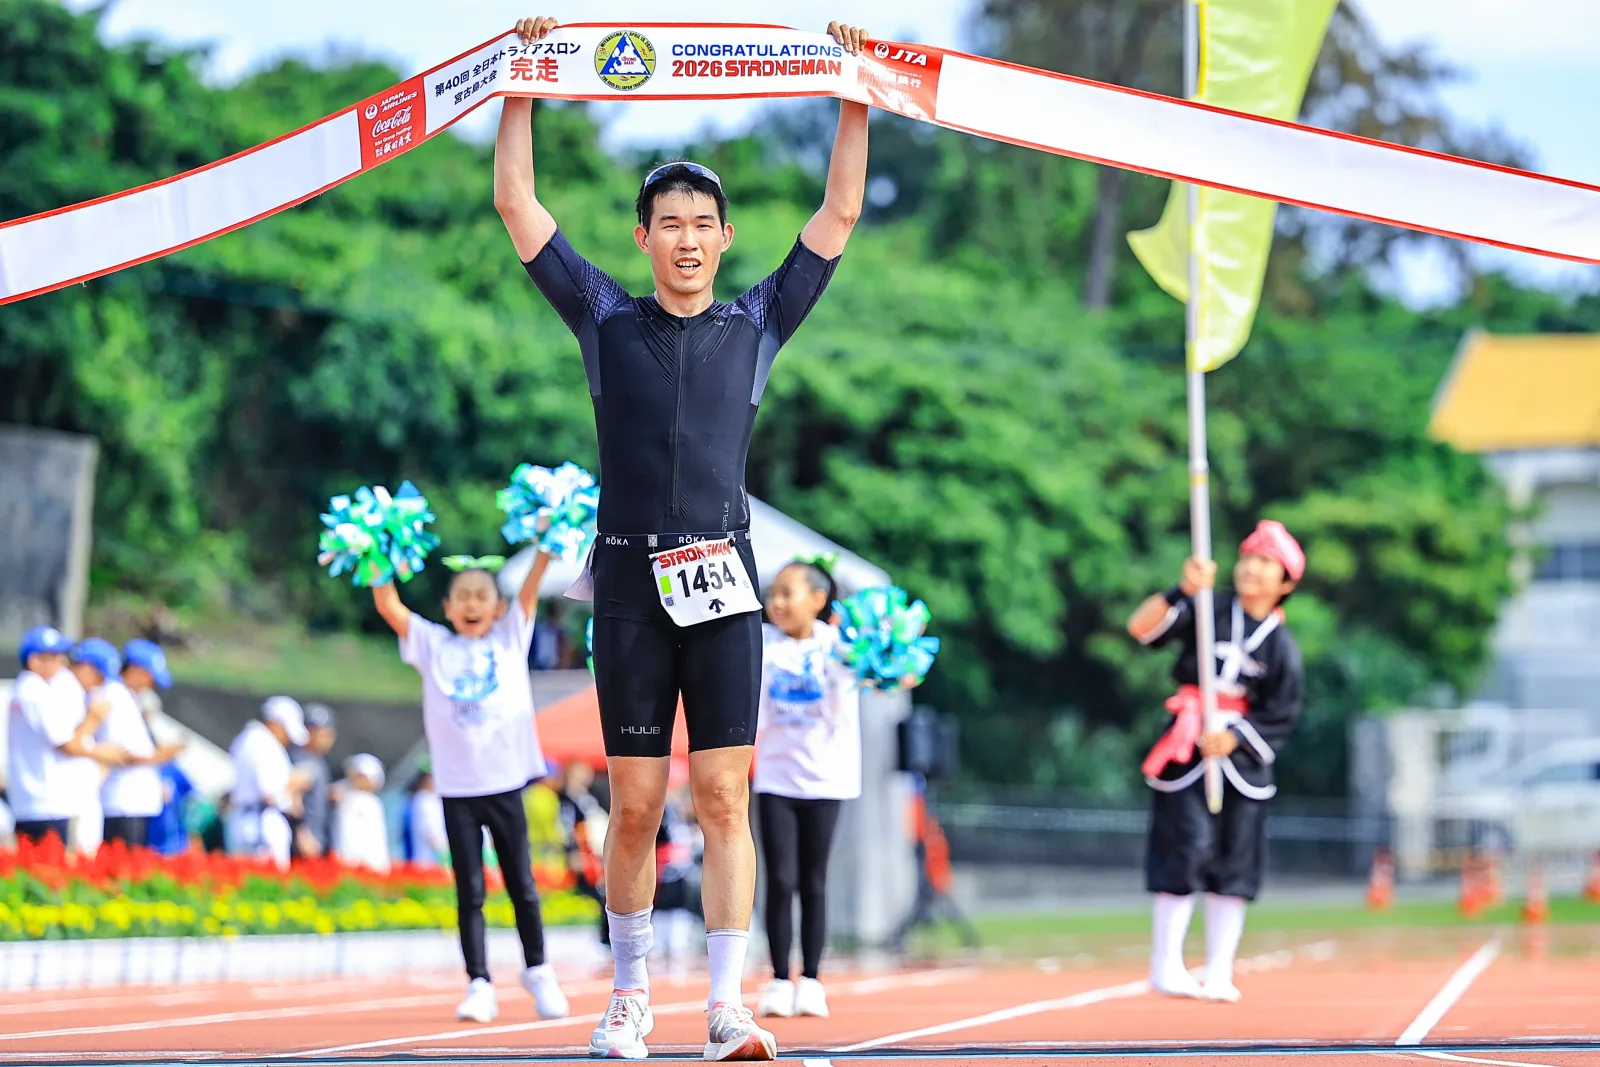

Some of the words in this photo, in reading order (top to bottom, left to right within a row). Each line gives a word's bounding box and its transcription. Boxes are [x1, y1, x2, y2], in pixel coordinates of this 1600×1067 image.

[671, 43, 843, 58] CONGRATULATIONS
[890, 48, 928, 66] JTA
[434, 70, 470, 97] 第40回
[472, 42, 581, 78] 全日本トライアスロン
[509, 56, 559, 83] 完走
[671, 59, 723, 77] 2026
[724, 59, 842, 77] STRONGMAN
[454, 69, 498, 105] 宮古島大会
[380, 91, 405, 107] JAPAN
[382, 91, 418, 113] AIRLINES
[657, 540, 732, 570] STRONGMAN
[677, 560, 737, 599] 1454
[620, 726, 661, 735] HUUB
